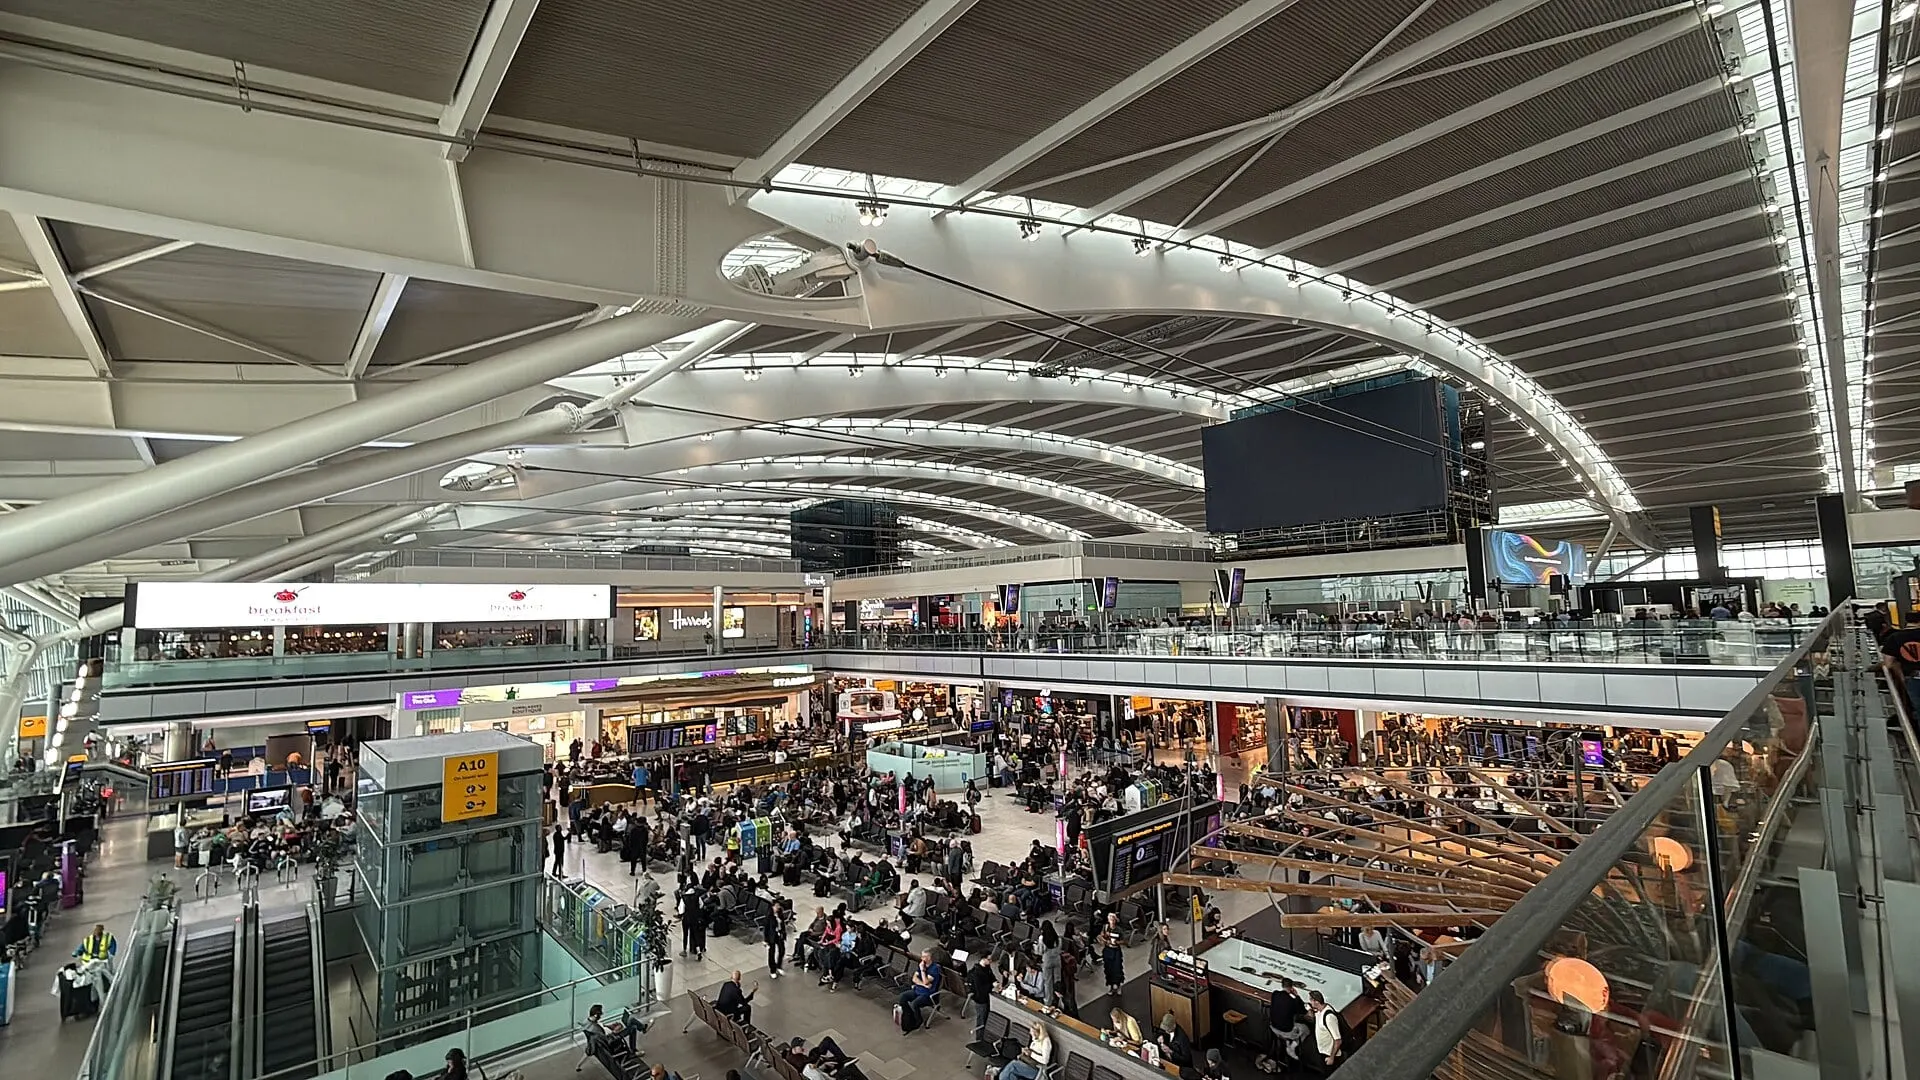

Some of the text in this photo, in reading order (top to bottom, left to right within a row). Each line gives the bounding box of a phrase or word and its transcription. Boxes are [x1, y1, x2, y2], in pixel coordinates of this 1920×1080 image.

[248, 605, 321, 614] breakfast
[668, 608, 712, 629] Harrods
[457, 759, 486, 772] A10
